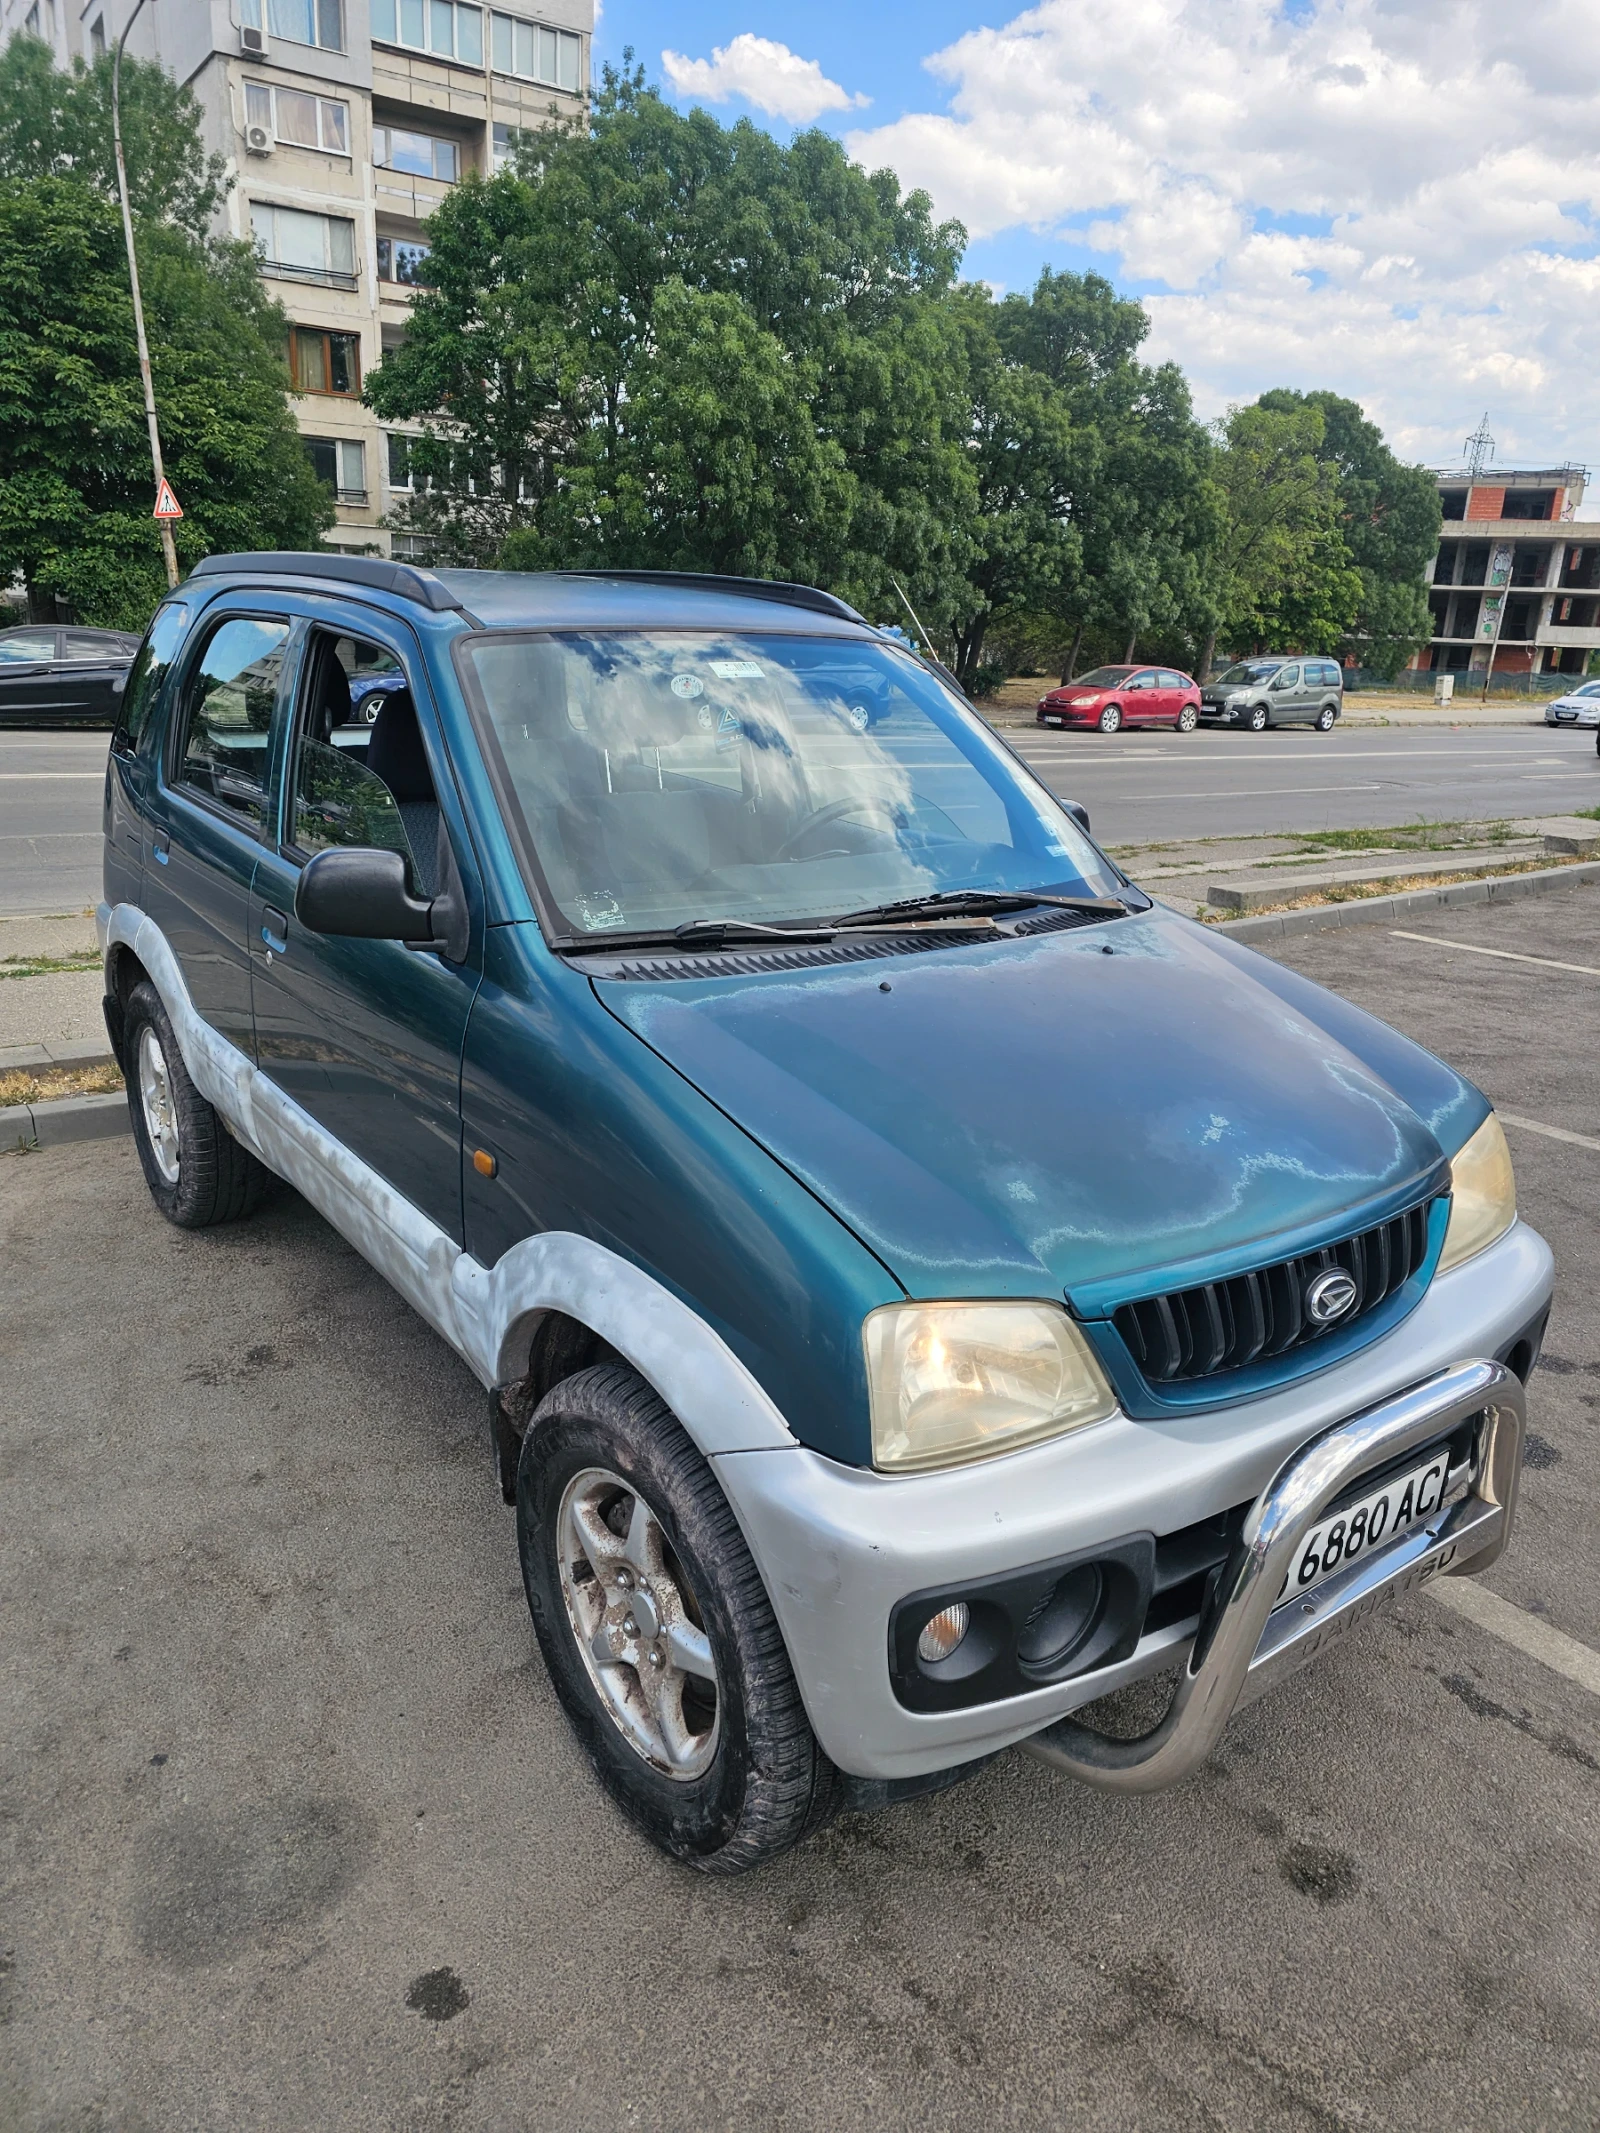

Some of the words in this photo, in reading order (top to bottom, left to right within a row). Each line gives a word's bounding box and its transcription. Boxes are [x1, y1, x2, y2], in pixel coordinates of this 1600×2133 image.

[1298, 1496, 1389, 1585] 6880
[1391, 1465, 1441, 1533] AC
[1300, 1544, 1458, 1659] DAIHATSU
